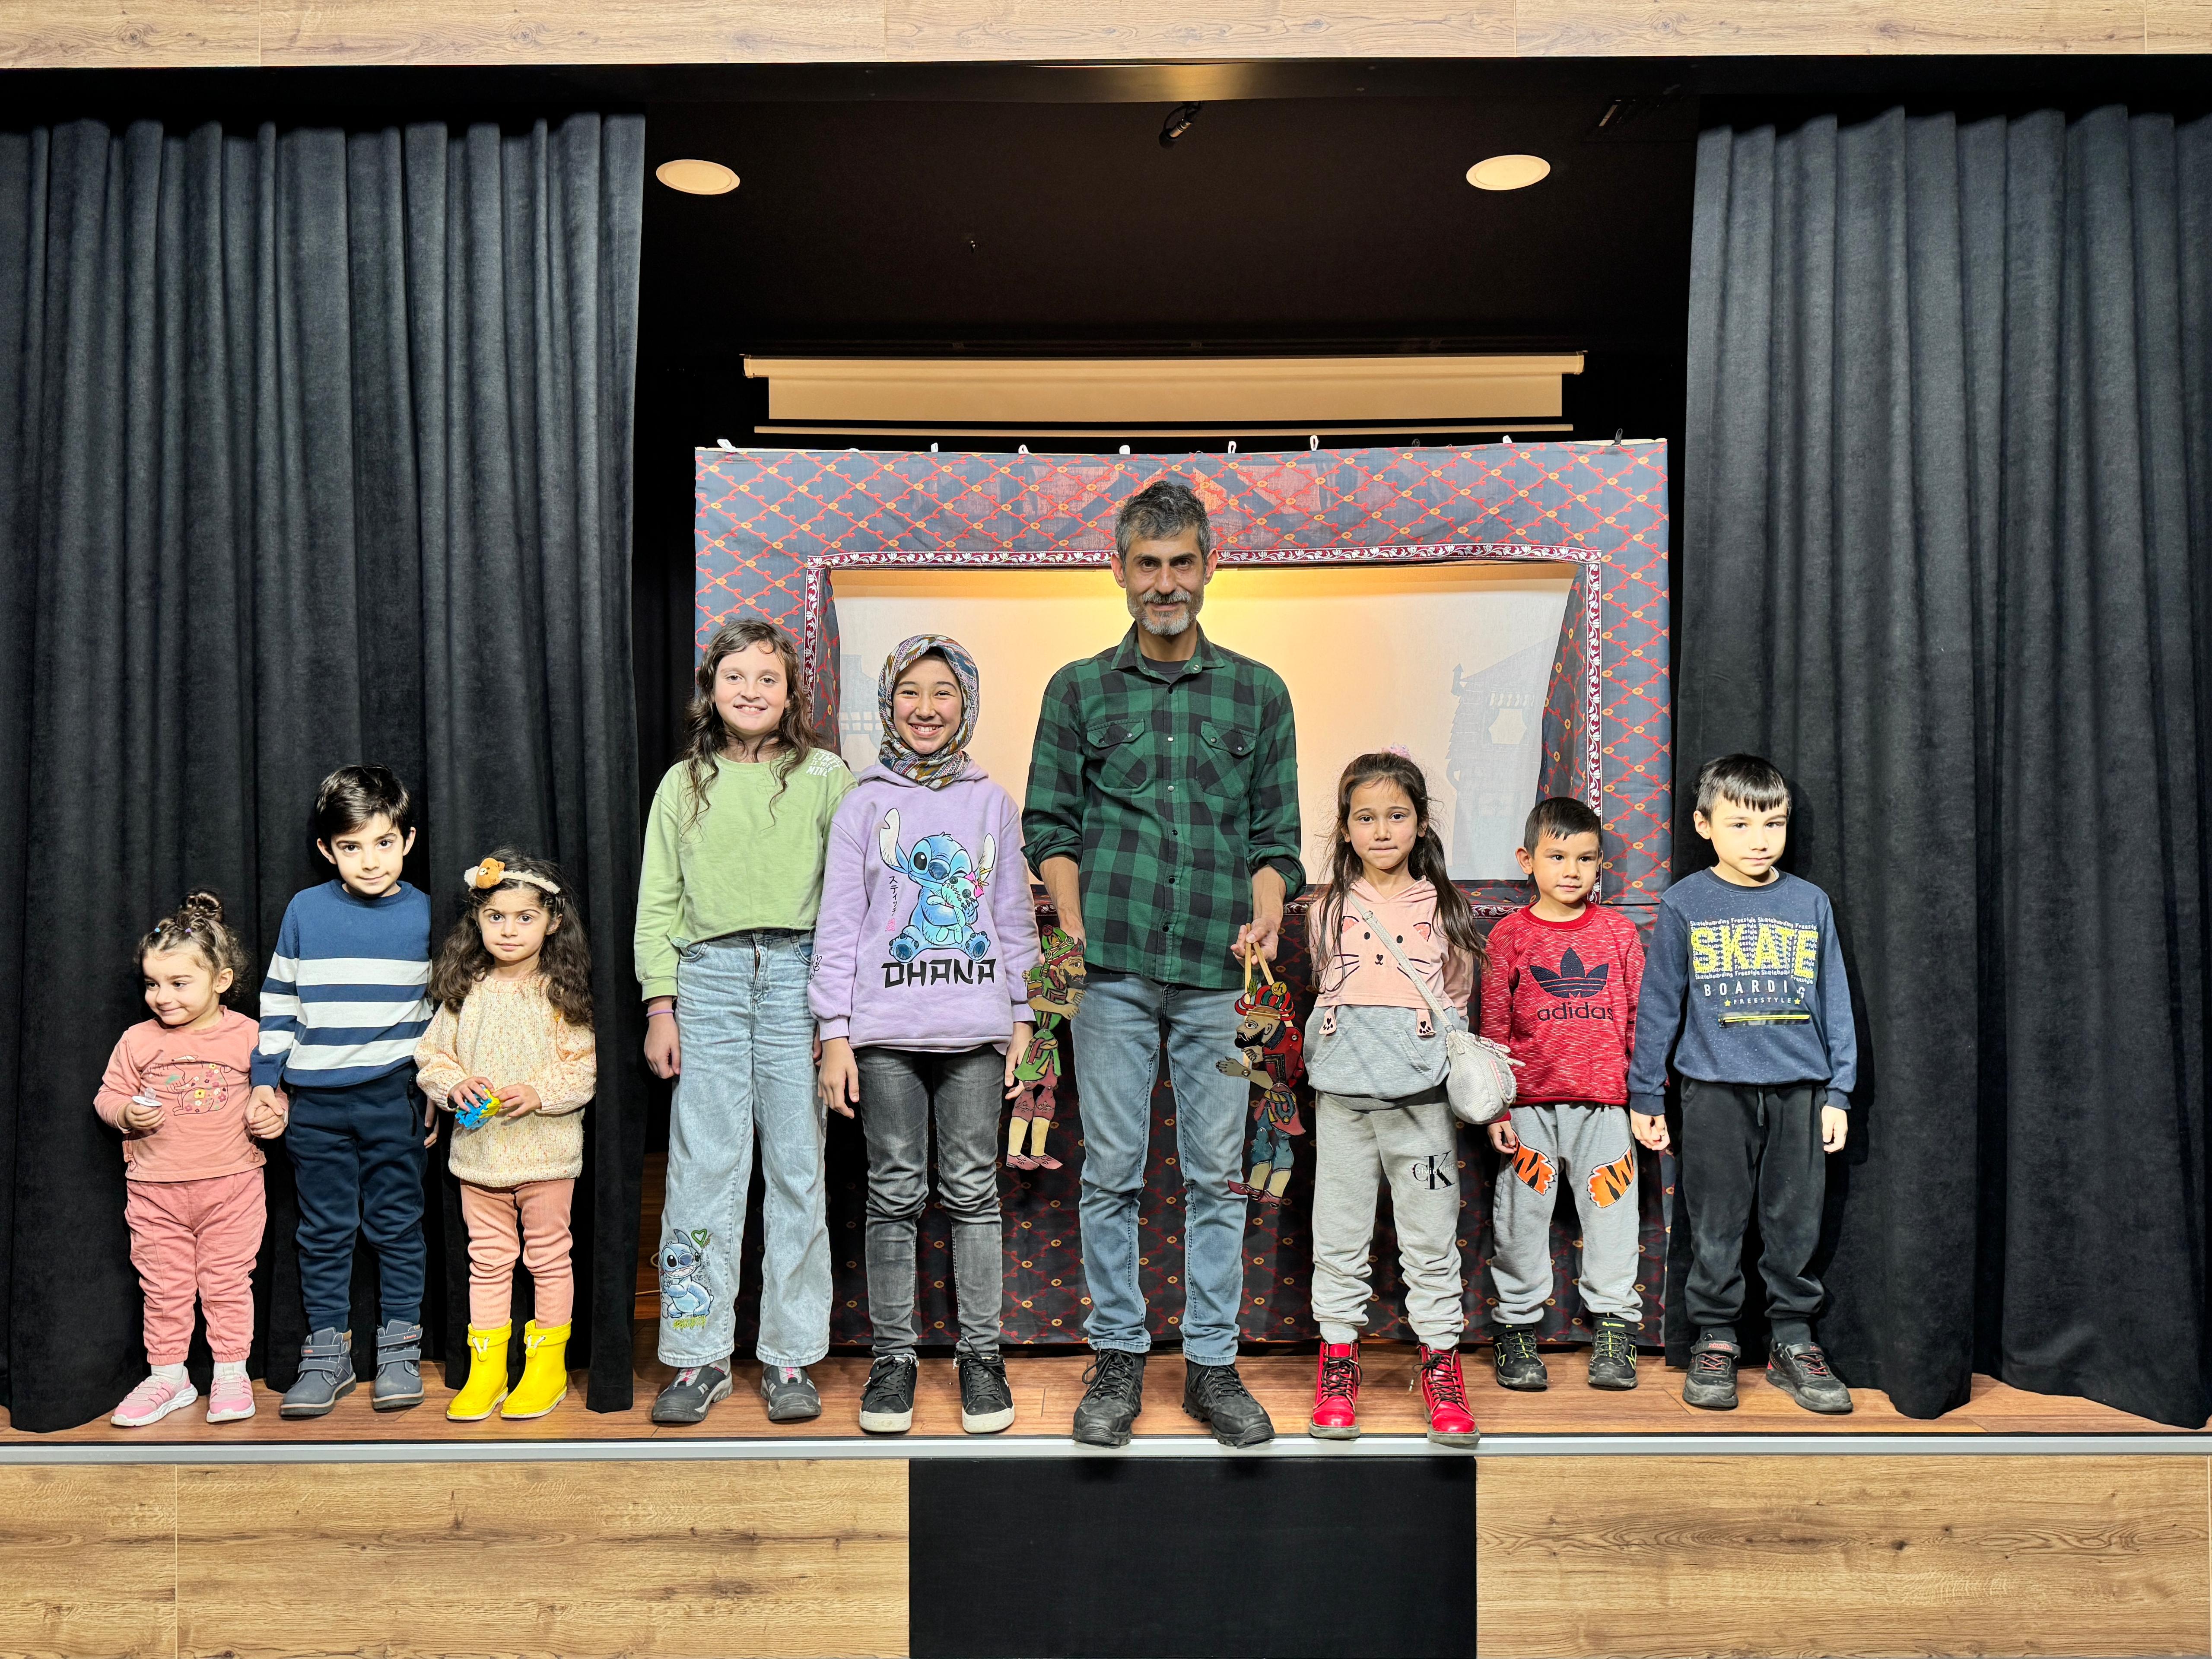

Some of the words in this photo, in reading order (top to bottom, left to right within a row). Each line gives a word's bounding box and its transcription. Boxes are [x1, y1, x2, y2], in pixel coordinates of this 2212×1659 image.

[1690, 918, 1730, 927] Skateboarding
[1690, 923, 1818, 979] SKATE
[881, 958, 996, 988] OHANA
[1694, 971, 1733, 980] Skateboarding
[1703, 980, 1805, 999] BOARDIG
[1537, 1002, 1614, 1021] adidas
[1412, 1150, 1455, 1190] CK
